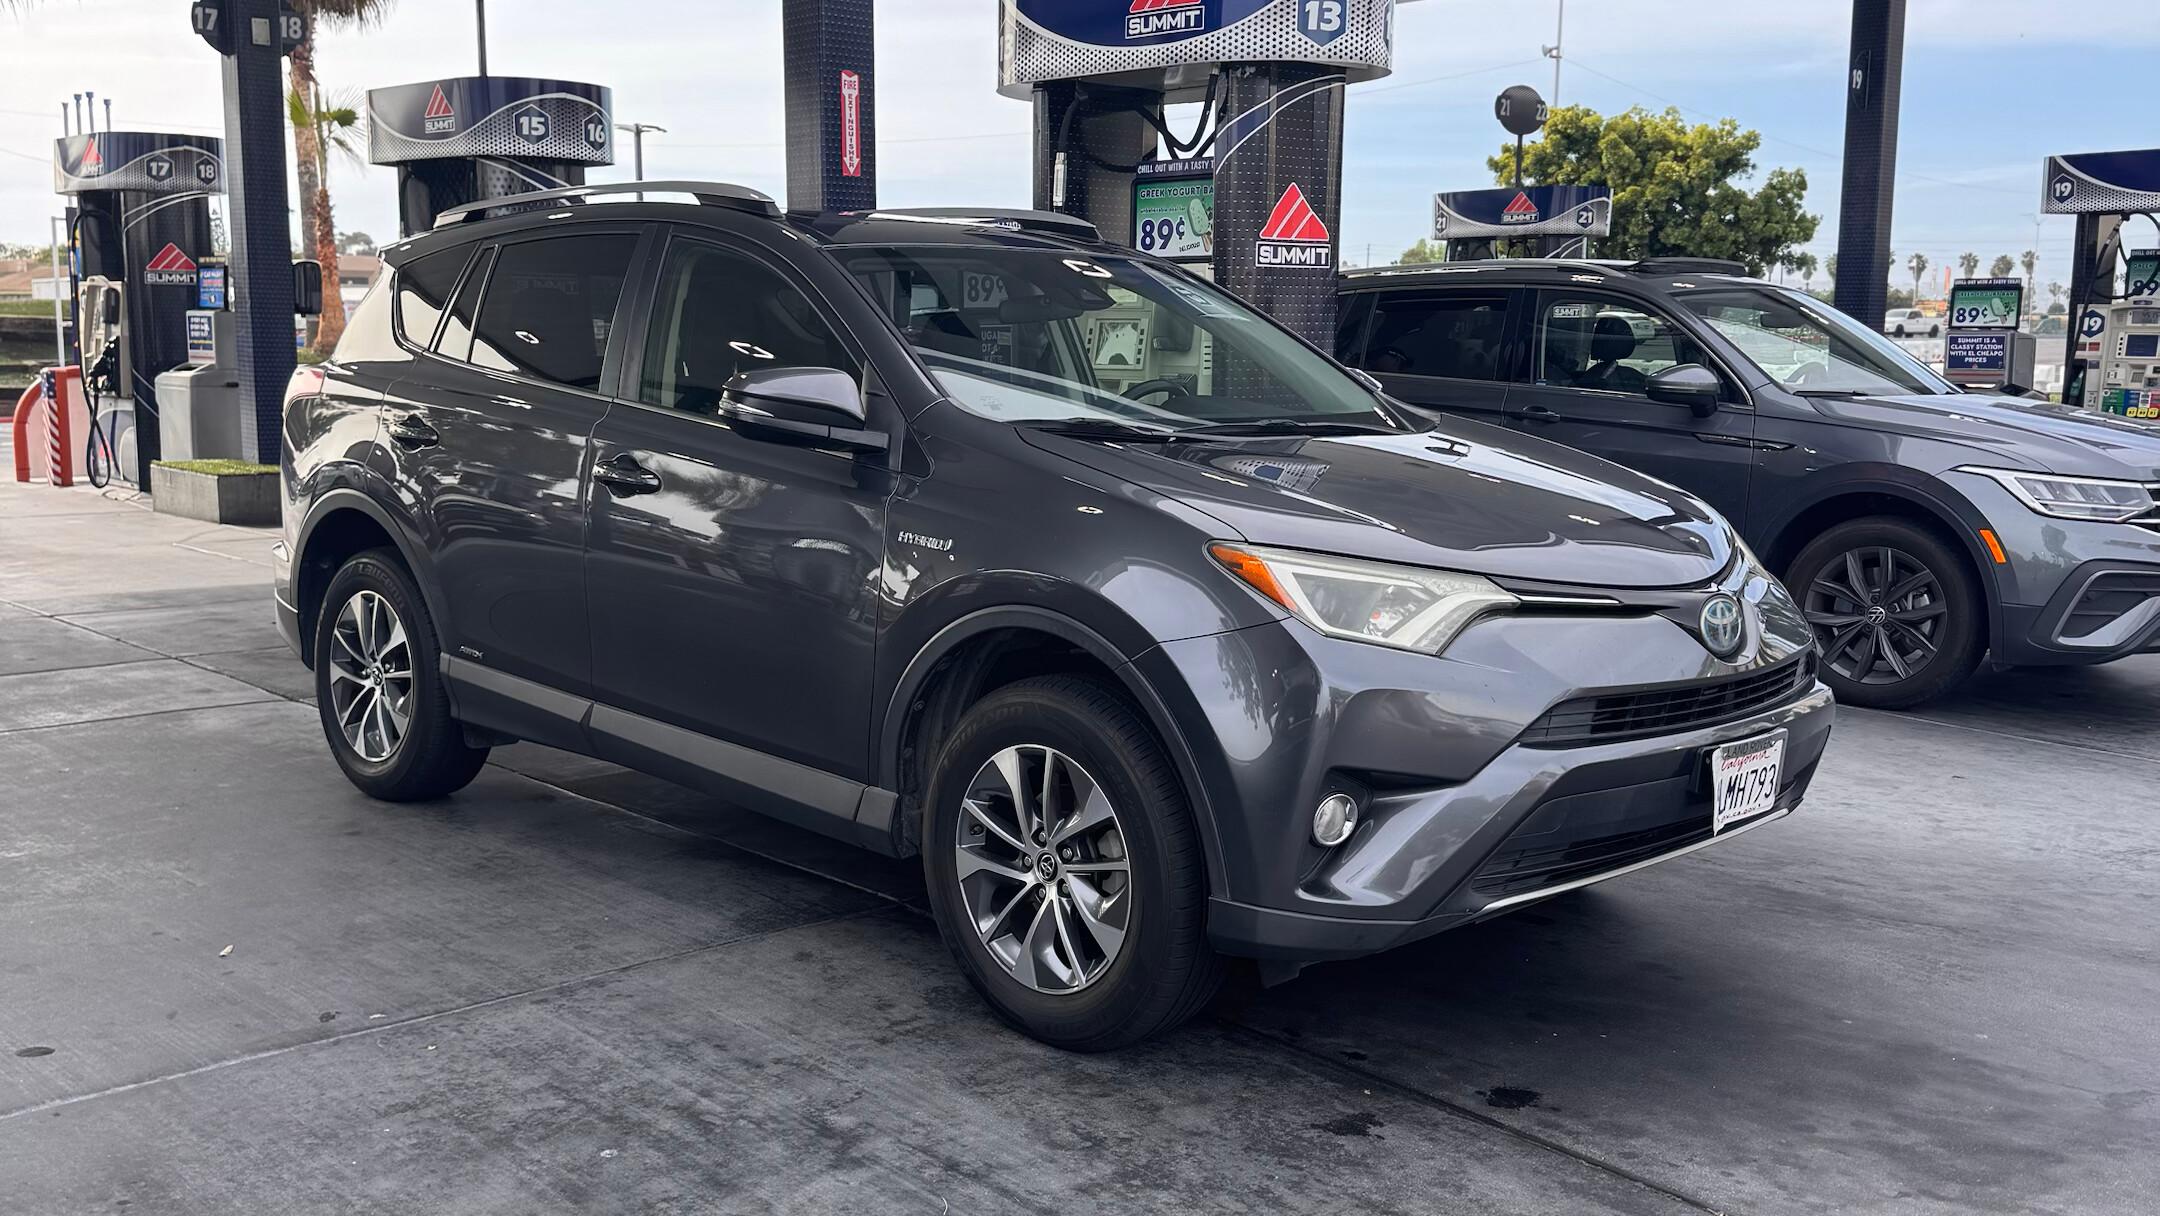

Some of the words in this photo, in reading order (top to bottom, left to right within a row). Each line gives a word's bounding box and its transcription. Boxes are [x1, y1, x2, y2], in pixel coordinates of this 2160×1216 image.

[194, 6, 218, 31] 17
[1128, 10, 1201, 35] SUMMIT
[1304, 1, 1342, 31] 13
[280, 16, 302, 39] 18
[843, 80, 857, 90] FIRE
[1852, 68, 1863, 89] 19
[1500, 98, 1510, 116] 21
[1535, 103, 1547, 121] 22
[425, 119, 454, 132] SUMMIT
[519, 116, 546, 136] 15
[587, 123, 606, 142] 16
[847, 93, 855, 168] EXTINGUISHER
[149, 161, 170, 177] 17
[198, 164, 215, 179] 18
[1137, 164, 1154, 174] CHILL
[1155, 163, 1167, 172] OUT
[1168, 162, 1183, 171] WITH
[1184, 162, 1189, 170] A
[1190, 160, 1209, 170] TASTY
[1140, 189, 1165, 198] GREEK
[1167, 186, 1201, 196] YOGURT
[1203, 185, 1214, 194] BA
[2053, 180, 2073, 197] 19
[1436, 217, 1446, 229] 21
[1503, 214, 1537, 222] SUMMIT
[1578, 211, 1593, 223] 21
[1140, 216, 1185, 251] 89¢
[1259, 245, 1329, 265] SUMMIT
[147, 273, 196, 283] SUMMIT
[1955, 306, 1988, 323] 89¢
[2083, 316, 2102, 331] 19
